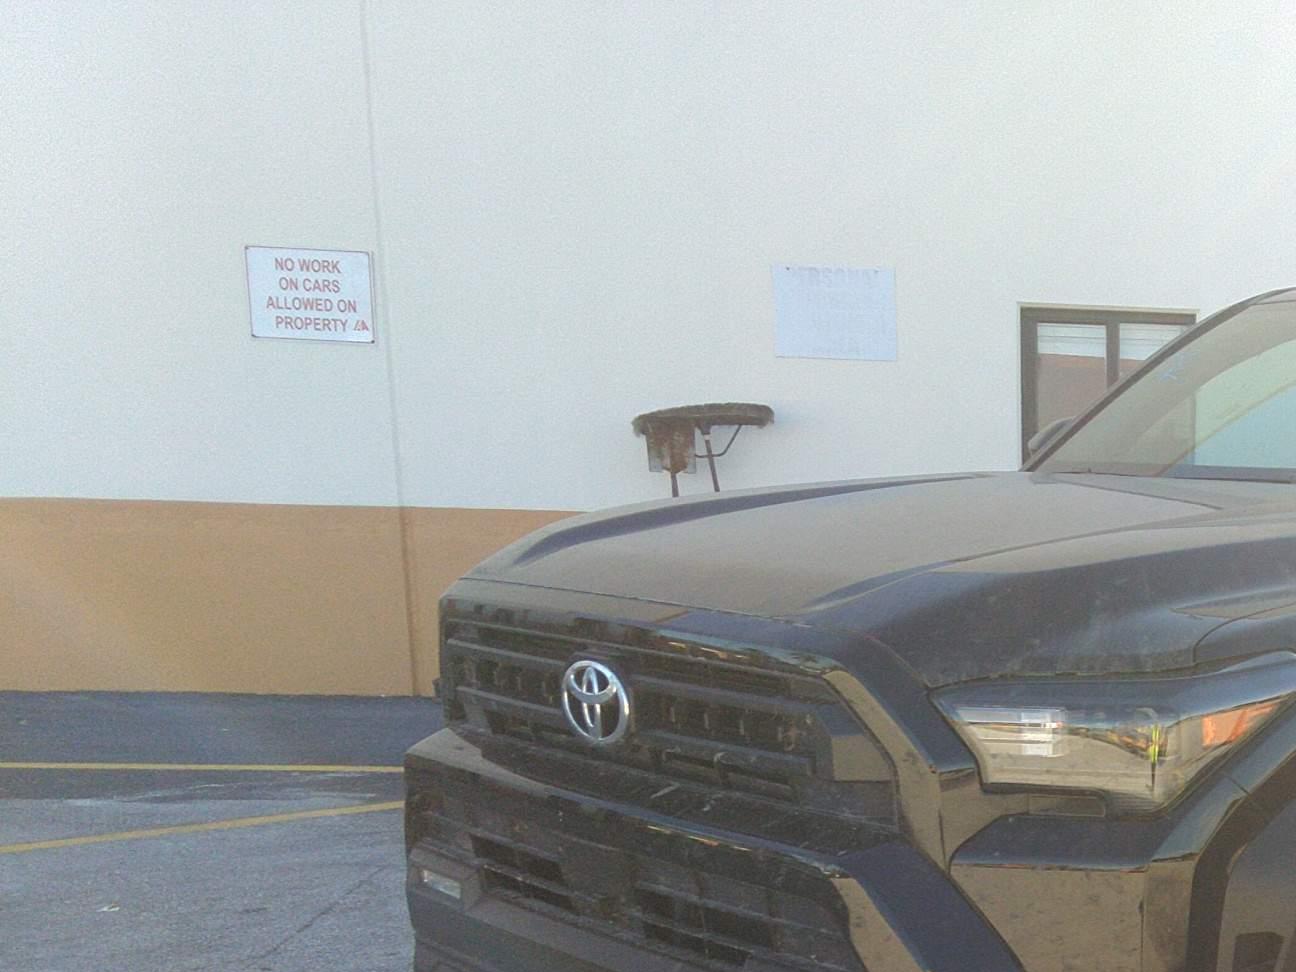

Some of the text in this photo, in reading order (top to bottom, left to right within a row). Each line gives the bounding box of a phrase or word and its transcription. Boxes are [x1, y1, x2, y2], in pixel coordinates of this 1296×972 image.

[275, 257, 341, 274] NO WORK
[279, 276, 341, 293] ON CARS
[266, 296, 357, 313] ALLOWED ON
[275, 316, 348, 332] PROPERTY
